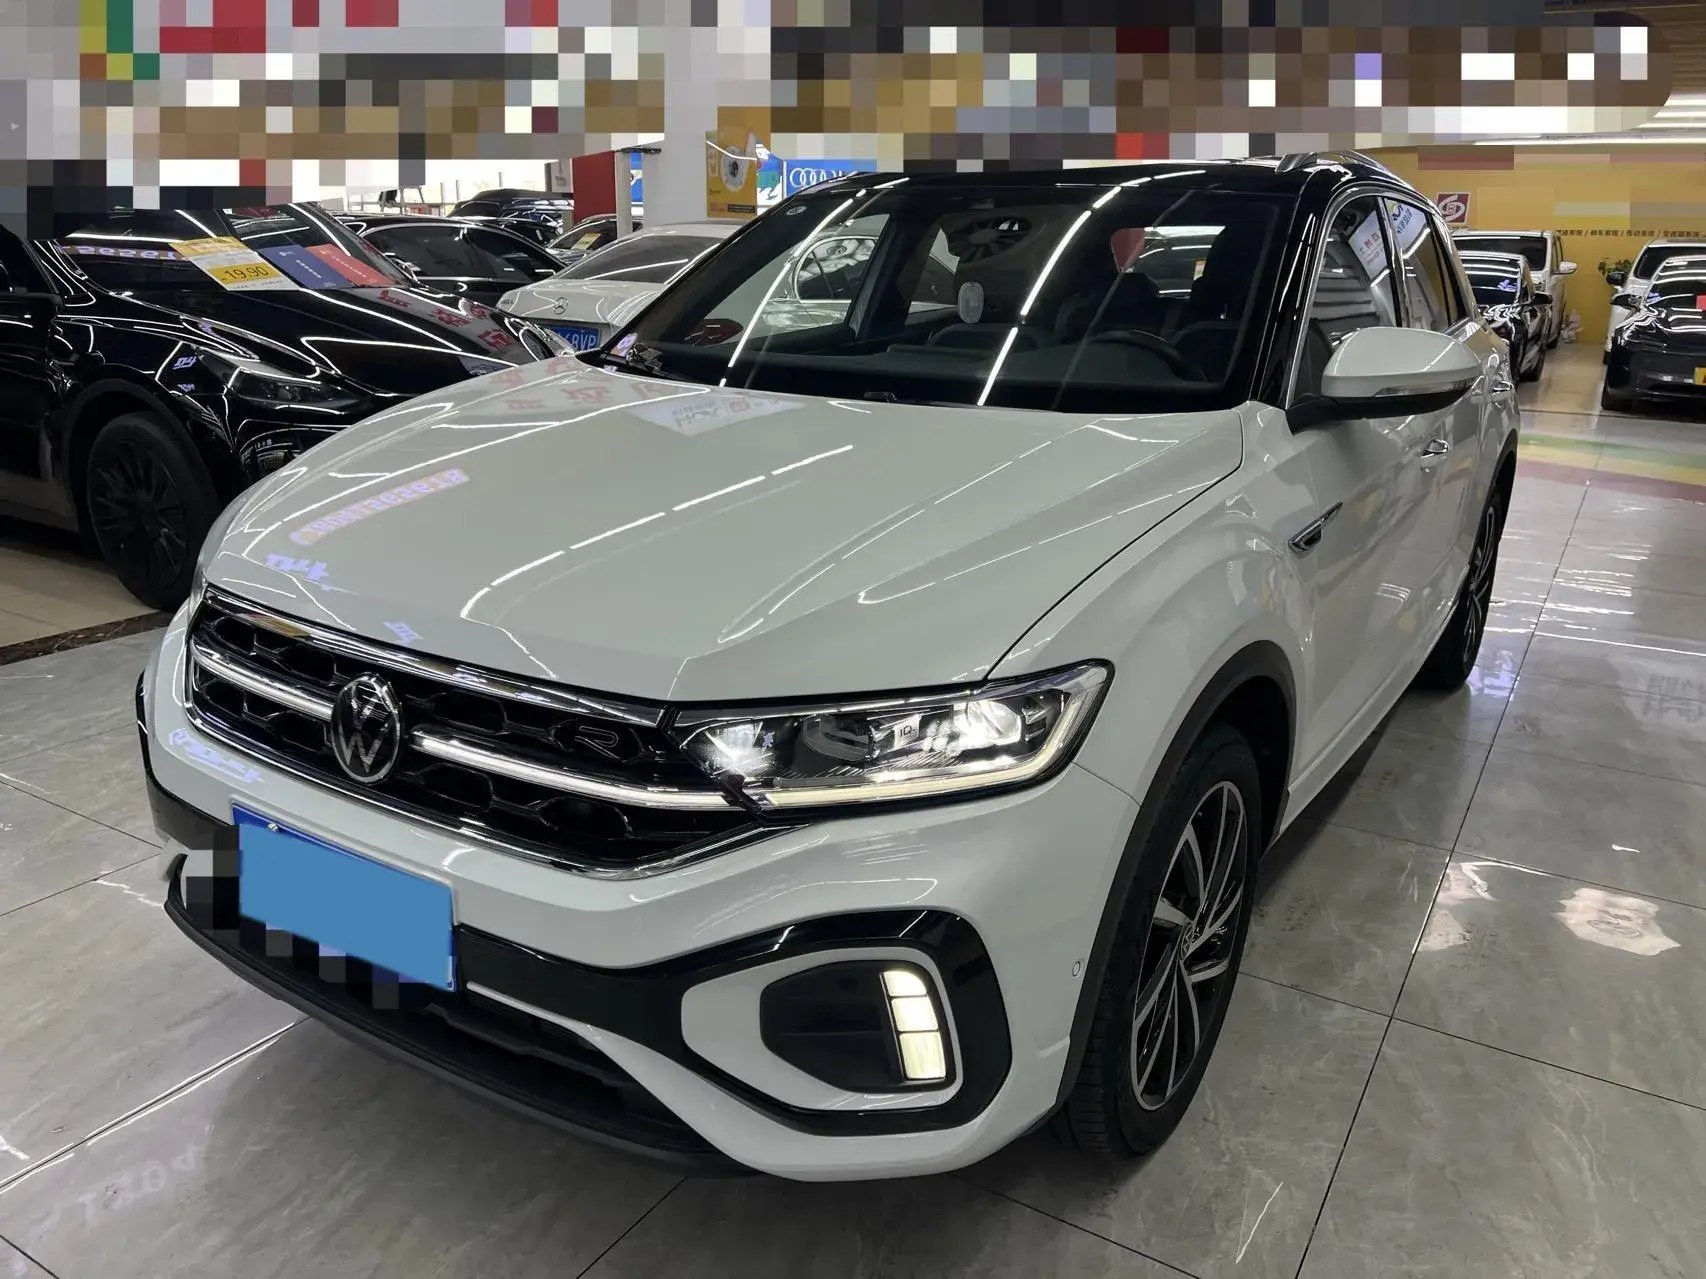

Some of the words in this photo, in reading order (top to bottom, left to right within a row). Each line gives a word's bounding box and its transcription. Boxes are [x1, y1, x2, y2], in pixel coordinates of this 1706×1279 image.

[224, 265, 270, 280] 19.90
[565, 333, 597, 351] 8VP
[574, 725, 621, 760] R
